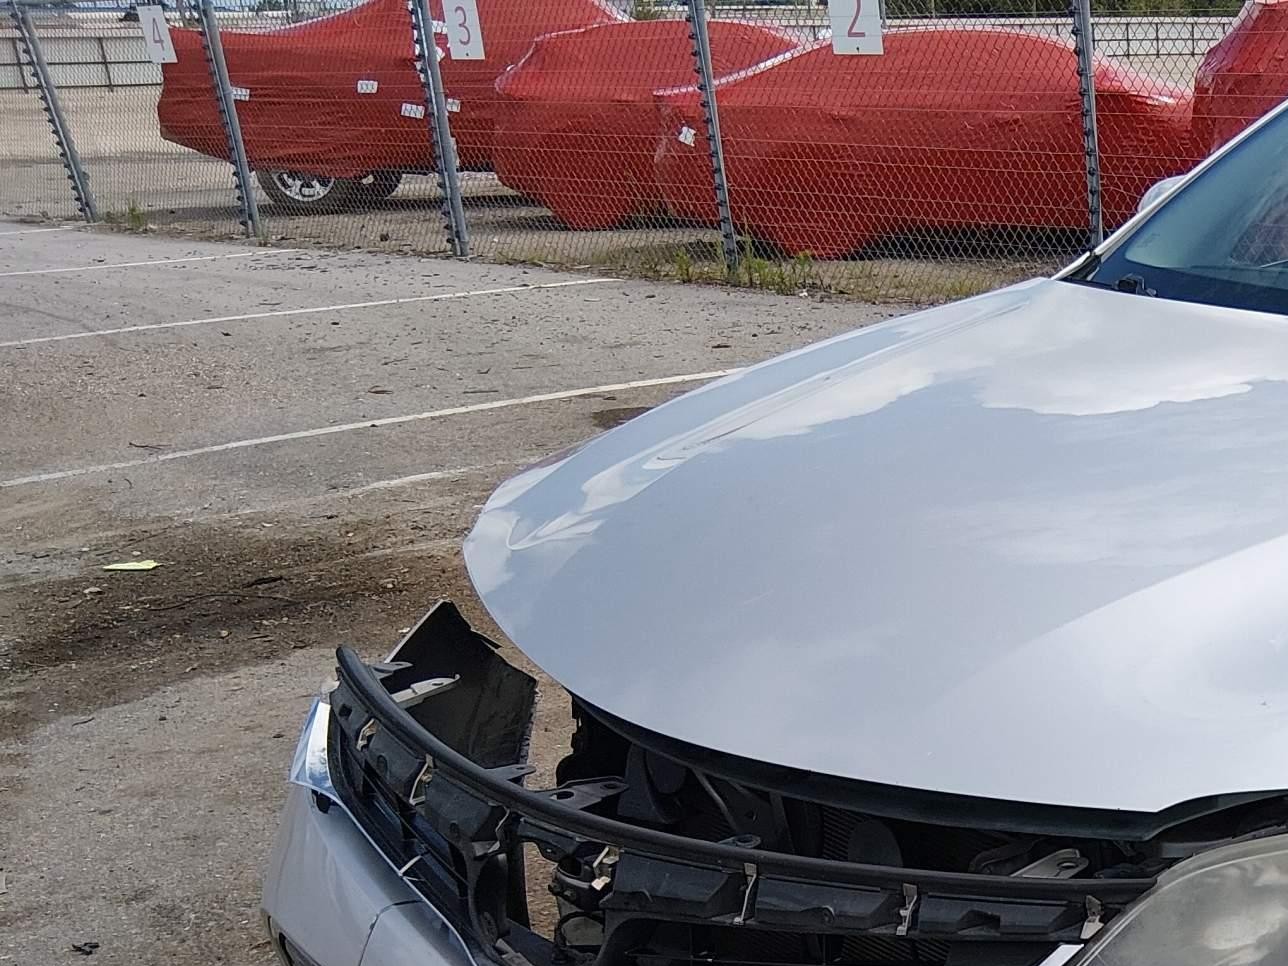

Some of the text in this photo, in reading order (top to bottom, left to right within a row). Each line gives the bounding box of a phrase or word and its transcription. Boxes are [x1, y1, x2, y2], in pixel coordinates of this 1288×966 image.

[152, 17, 165, 51] 4
[454, 6, 471, 46] 3
[847, 0, 866, 38] 2
